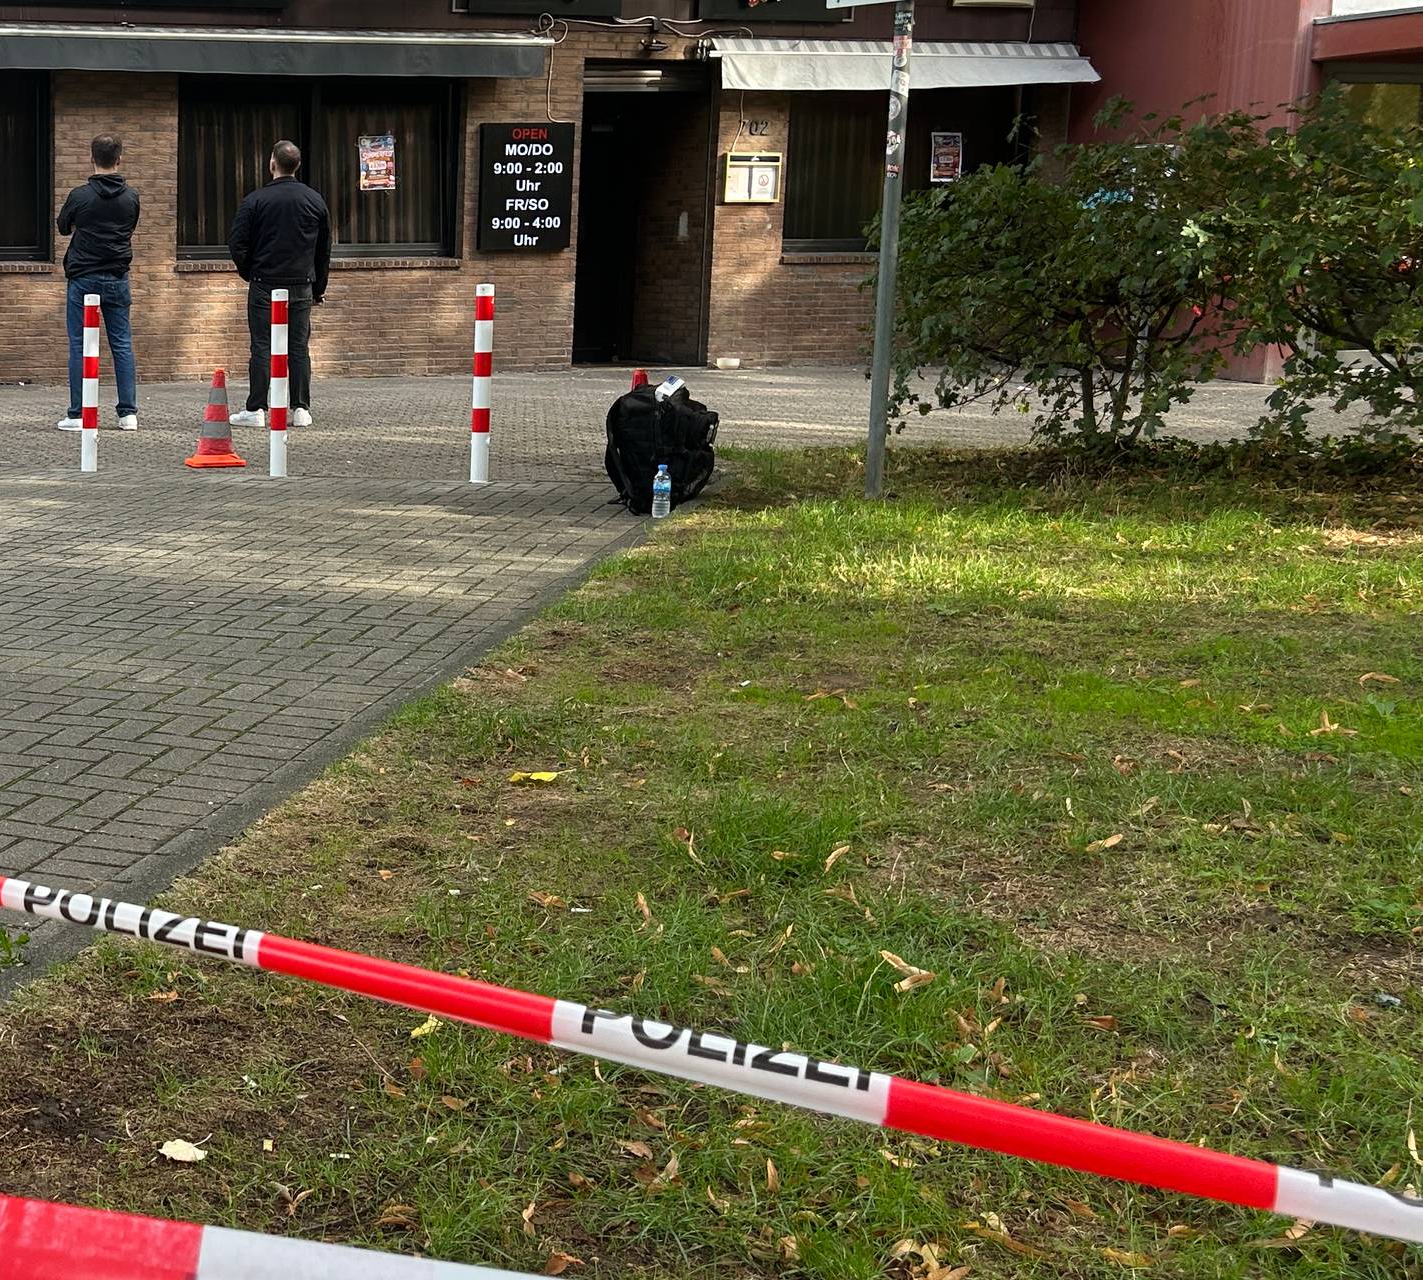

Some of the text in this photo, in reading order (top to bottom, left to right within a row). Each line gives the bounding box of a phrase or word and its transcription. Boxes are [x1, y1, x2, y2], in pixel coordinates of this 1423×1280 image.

[512, 128, 548, 140] OPEN
[739, 119, 770, 136] 702
[505, 143, 554, 156] MO/DO
[493, 162, 523, 175] 9:00
[534, 161, 563, 174] 2:00
[515, 179, 541, 192] Uhr
[505, 198, 549, 211] FR/SO
[491, 217, 521, 230] 9:00
[532, 216, 561, 229] 4:00
[513, 233, 539, 247] Uhr
